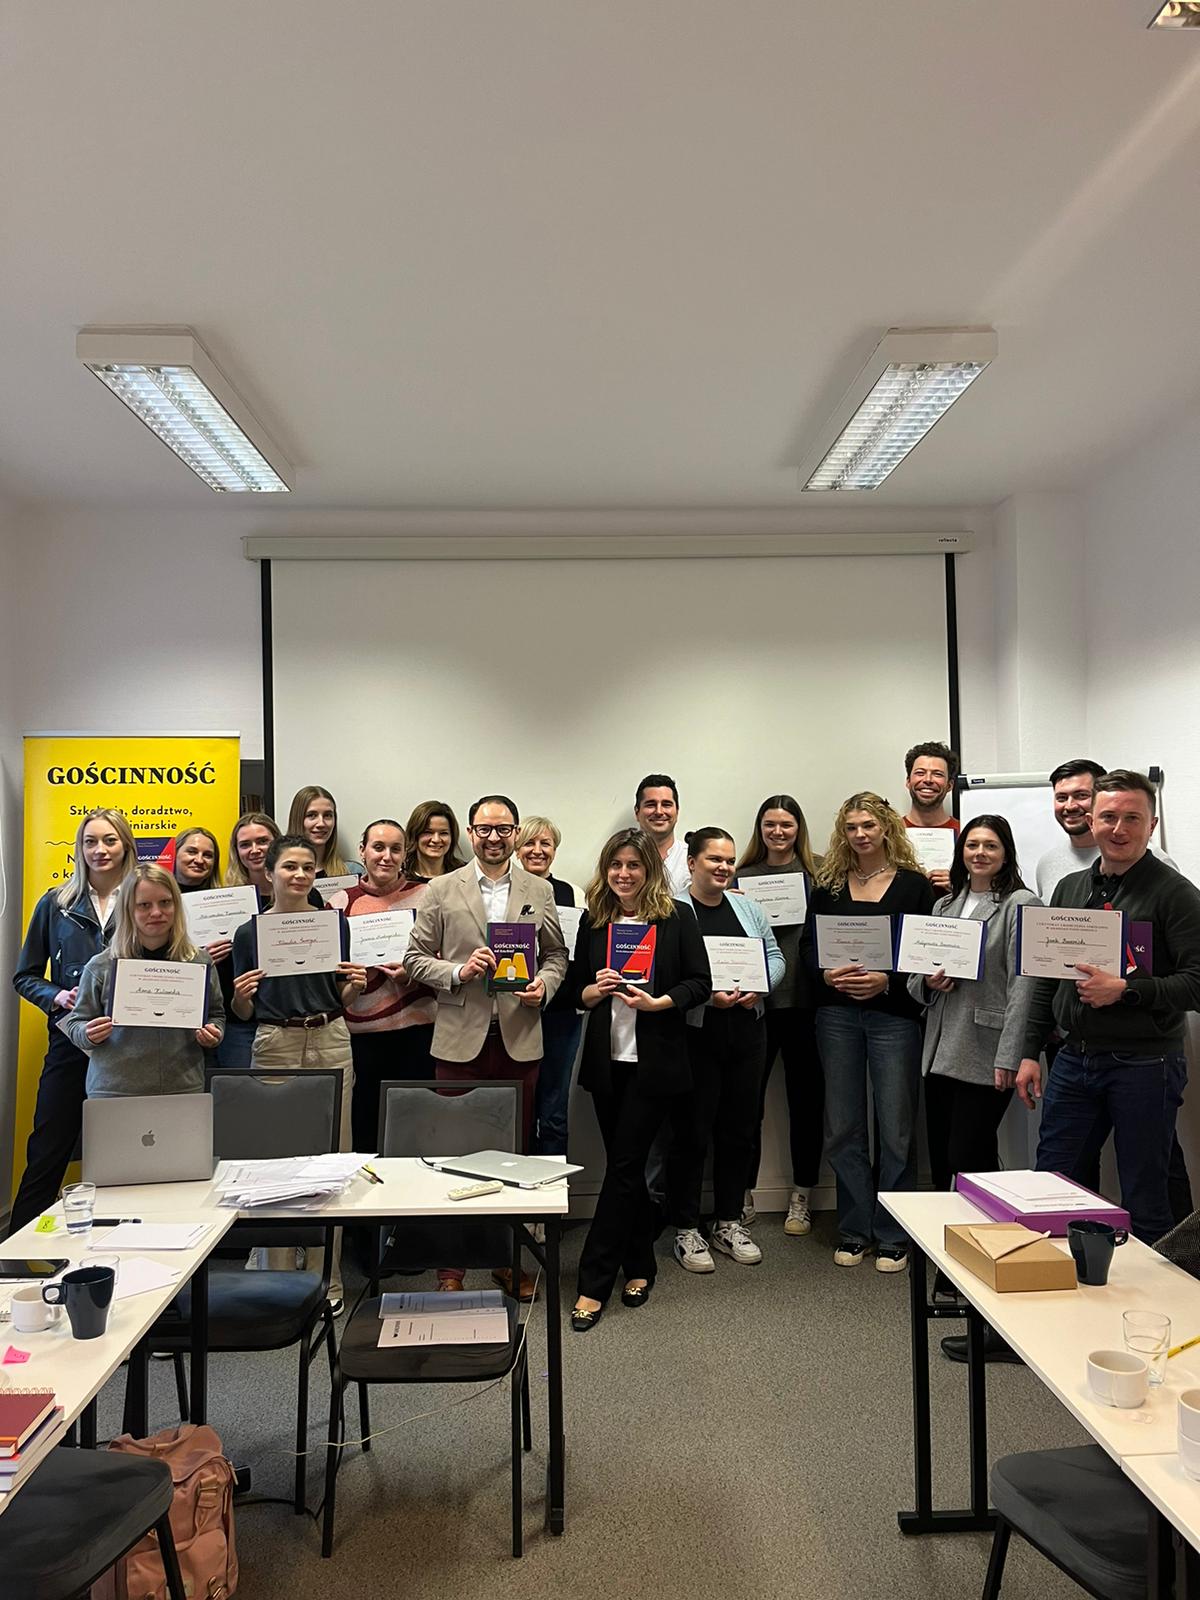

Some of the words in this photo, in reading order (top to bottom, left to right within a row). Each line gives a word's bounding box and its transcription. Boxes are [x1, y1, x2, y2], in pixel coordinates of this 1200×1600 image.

[47, 762, 215, 785] GOŚCINNOŚĆ
[131, 805, 193, 817] doradztwo,
[129, 820, 177, 830] iniarskie
[1050, 914, 1092, 923] GOŚCINNOŚĆ
[493, 942, 530, 950] GOŚCINNOŚĆ
[615, 943, 652, 951] GOŚCINNOŚĆ
